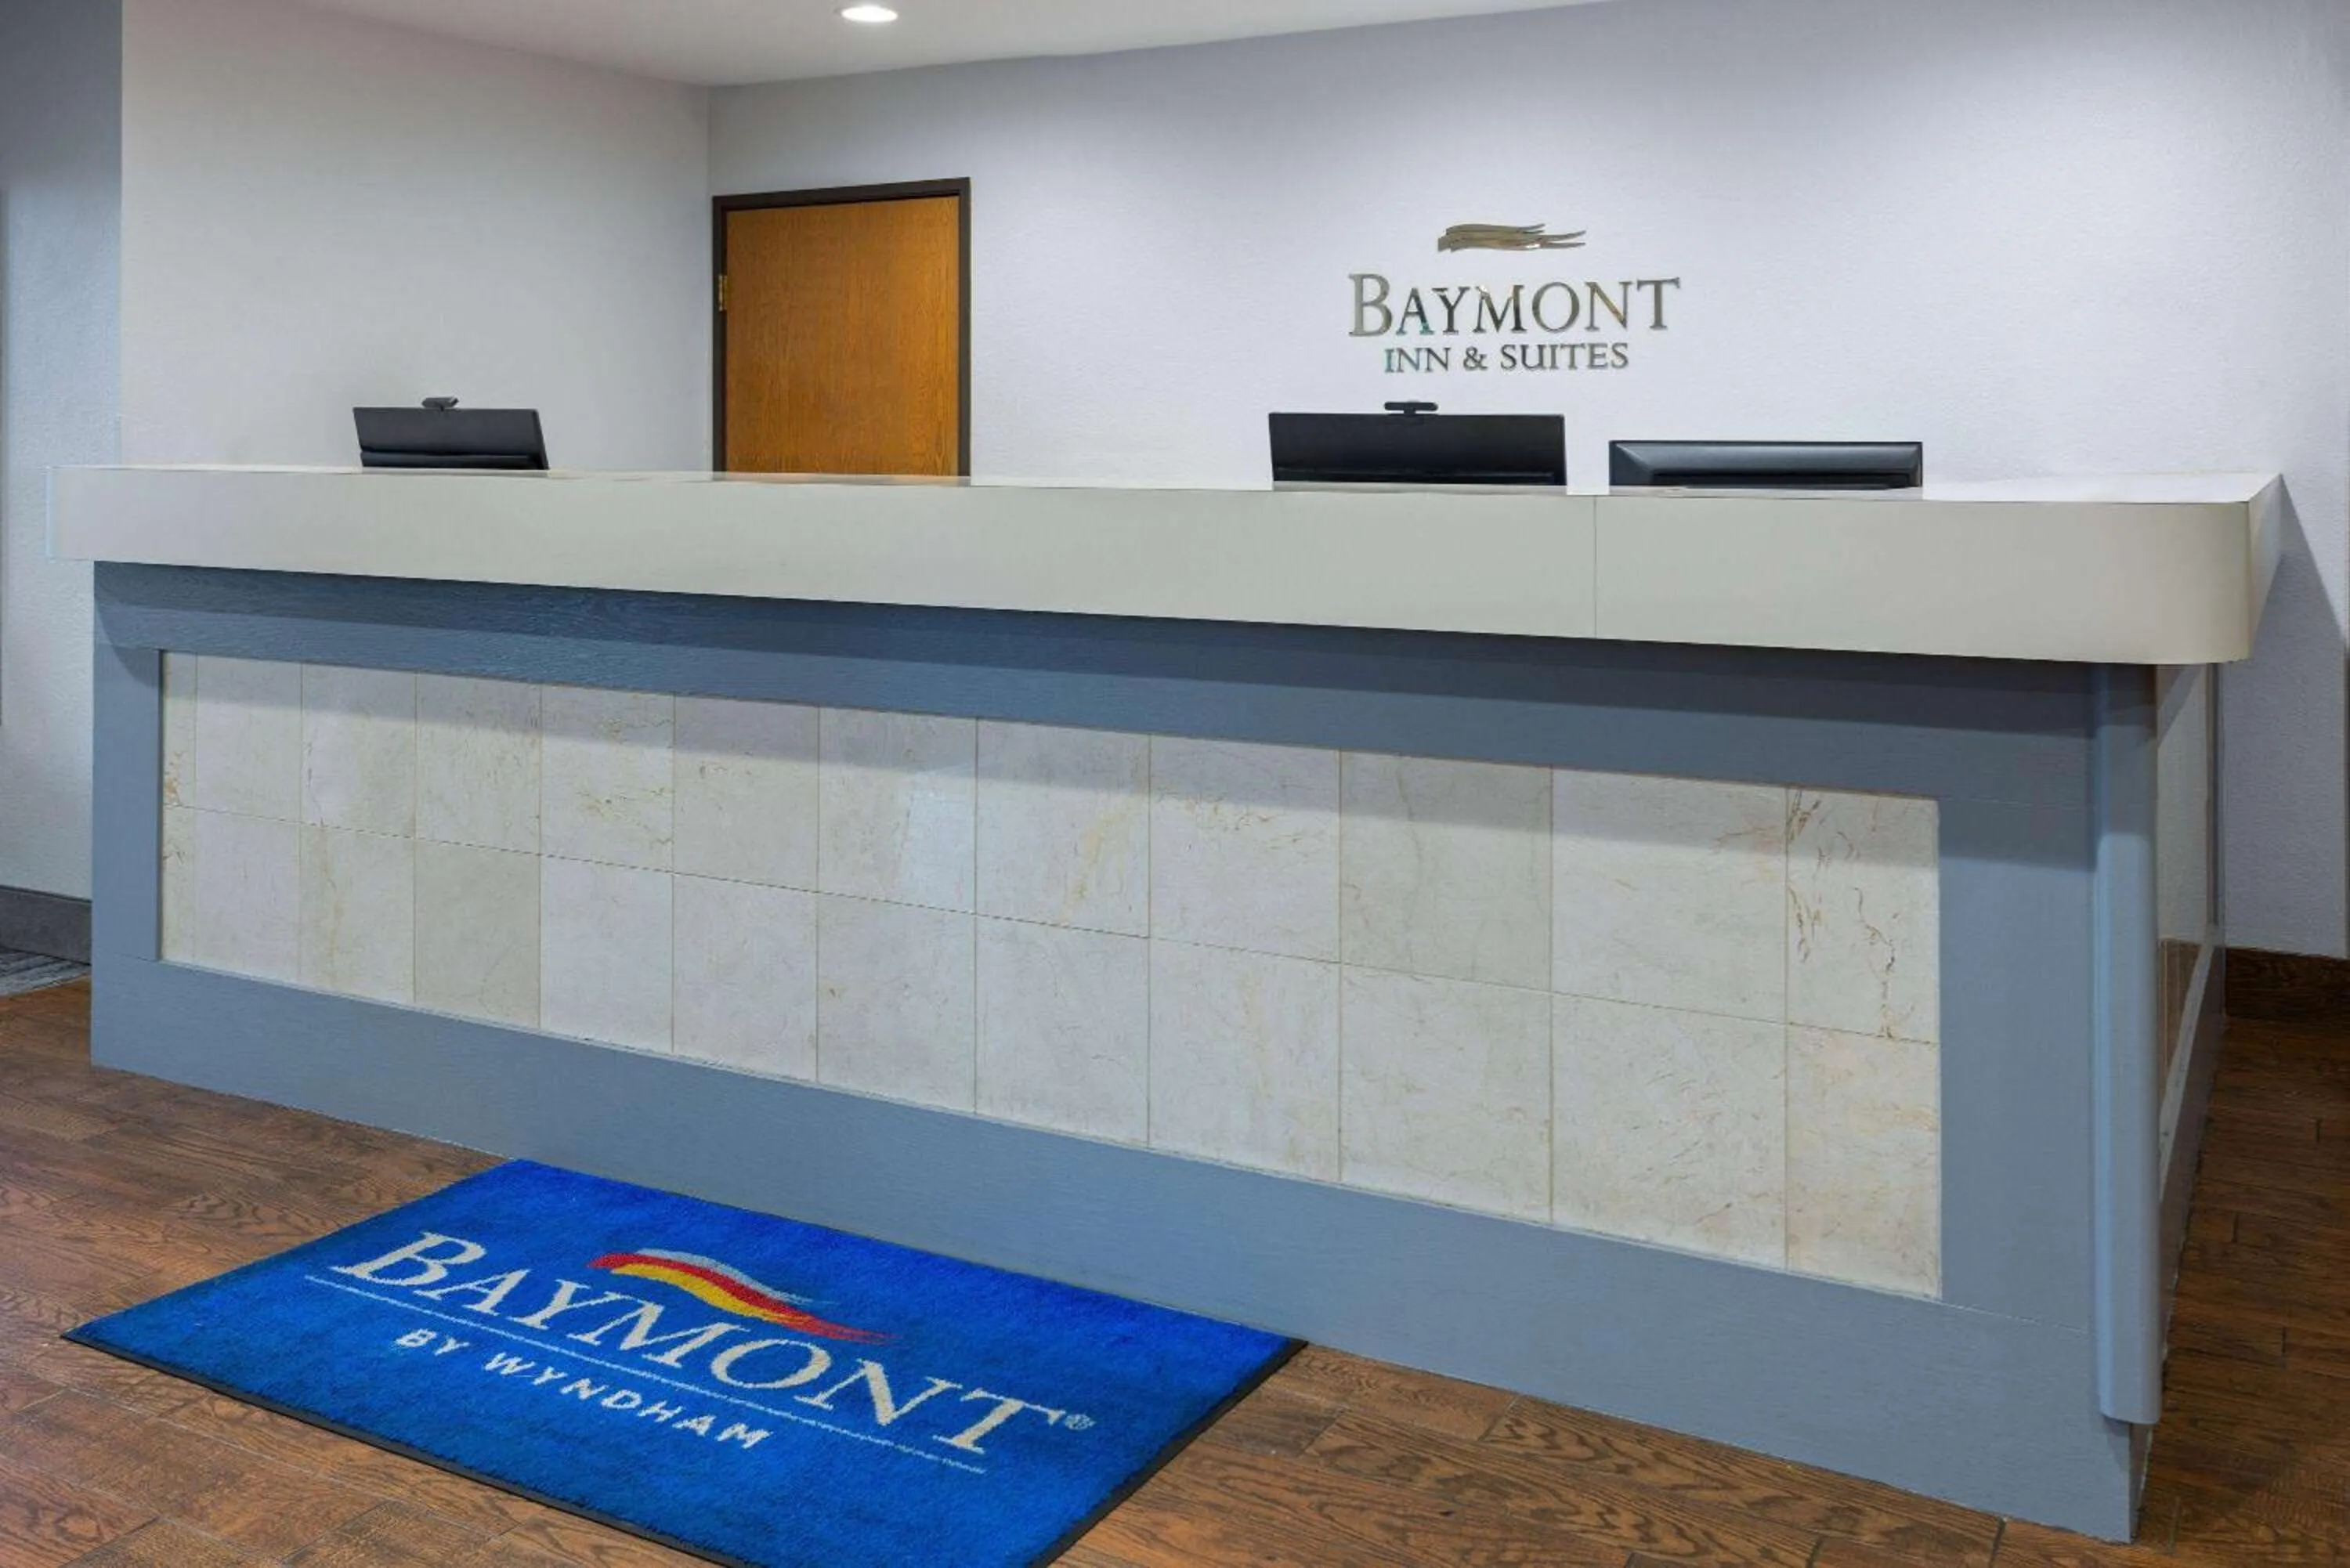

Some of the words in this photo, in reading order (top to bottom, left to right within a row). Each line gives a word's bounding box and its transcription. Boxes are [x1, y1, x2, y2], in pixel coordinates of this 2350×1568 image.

[1347, 273, 1682, 338] BAYMONT
[1384, 346, 1452, 374] INN
[1462, 345, 1488, 372] &
[1499, 341, 1629, 371] SUITES
[392, 1327, 470, 1357] BY
[483, 1351, 774, 1450] WYNDHAM
